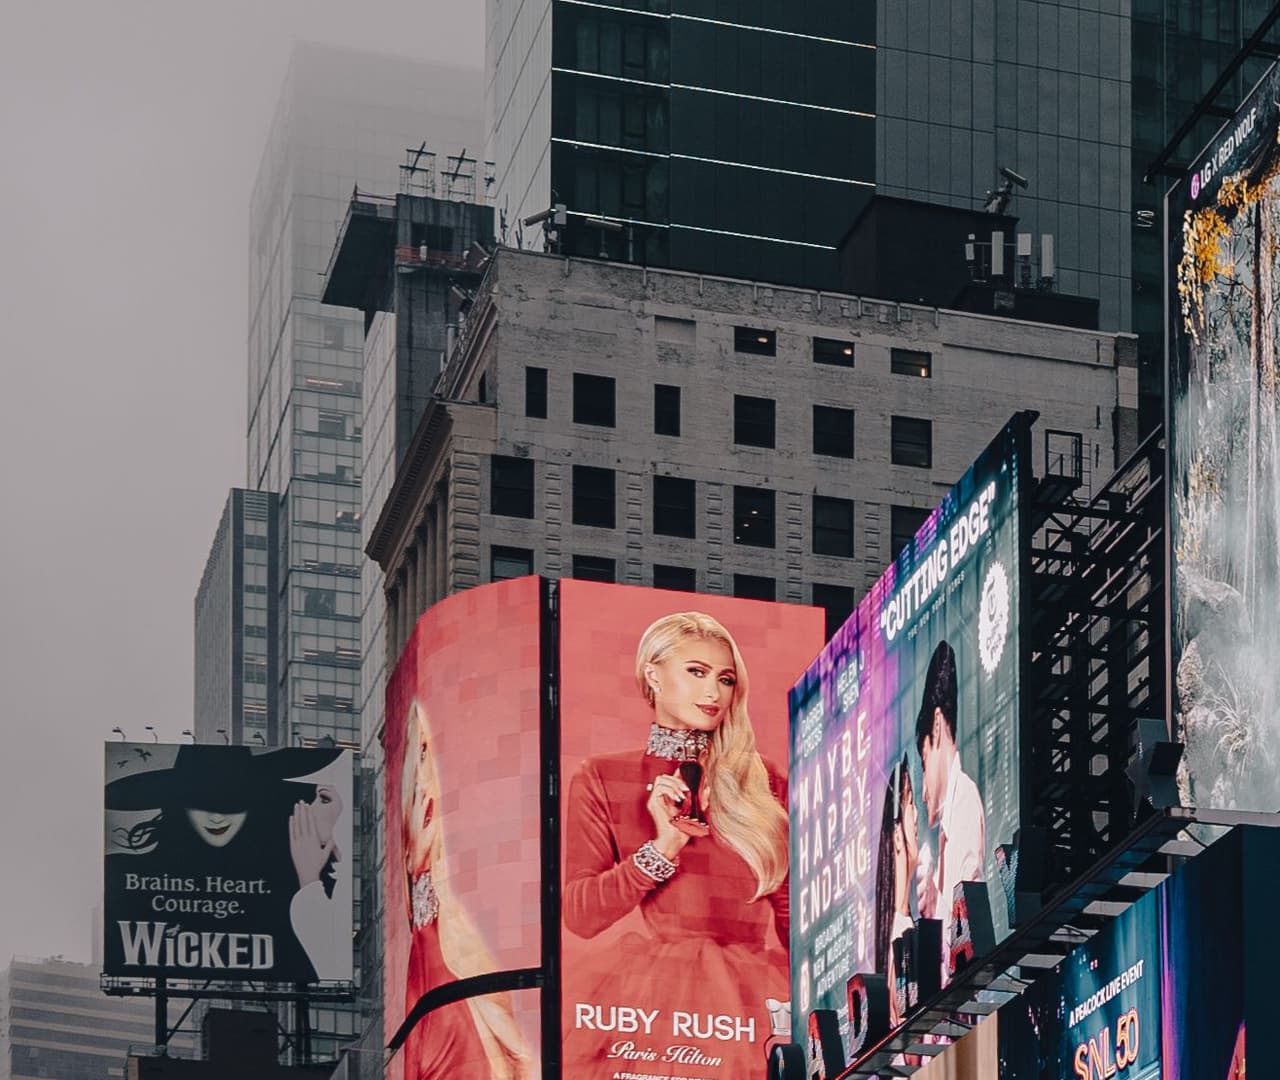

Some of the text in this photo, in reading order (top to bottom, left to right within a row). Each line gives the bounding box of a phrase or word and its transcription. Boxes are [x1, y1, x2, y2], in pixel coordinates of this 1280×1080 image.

[1234, 107, 1257, 148] WOLF
[798, 710, 868, 826] MAYBE
[799, 767, 868, 880] HAPPY
[124, 873, 272, 894] Brains. Heart.
[799, 825, 868, 935] ENDING
[151, 895, 246, 918] Courage.
[575, 1003, 756, 1043] RUBY RUSH
[607, 1039, 723, 1068] Paris Hilton
